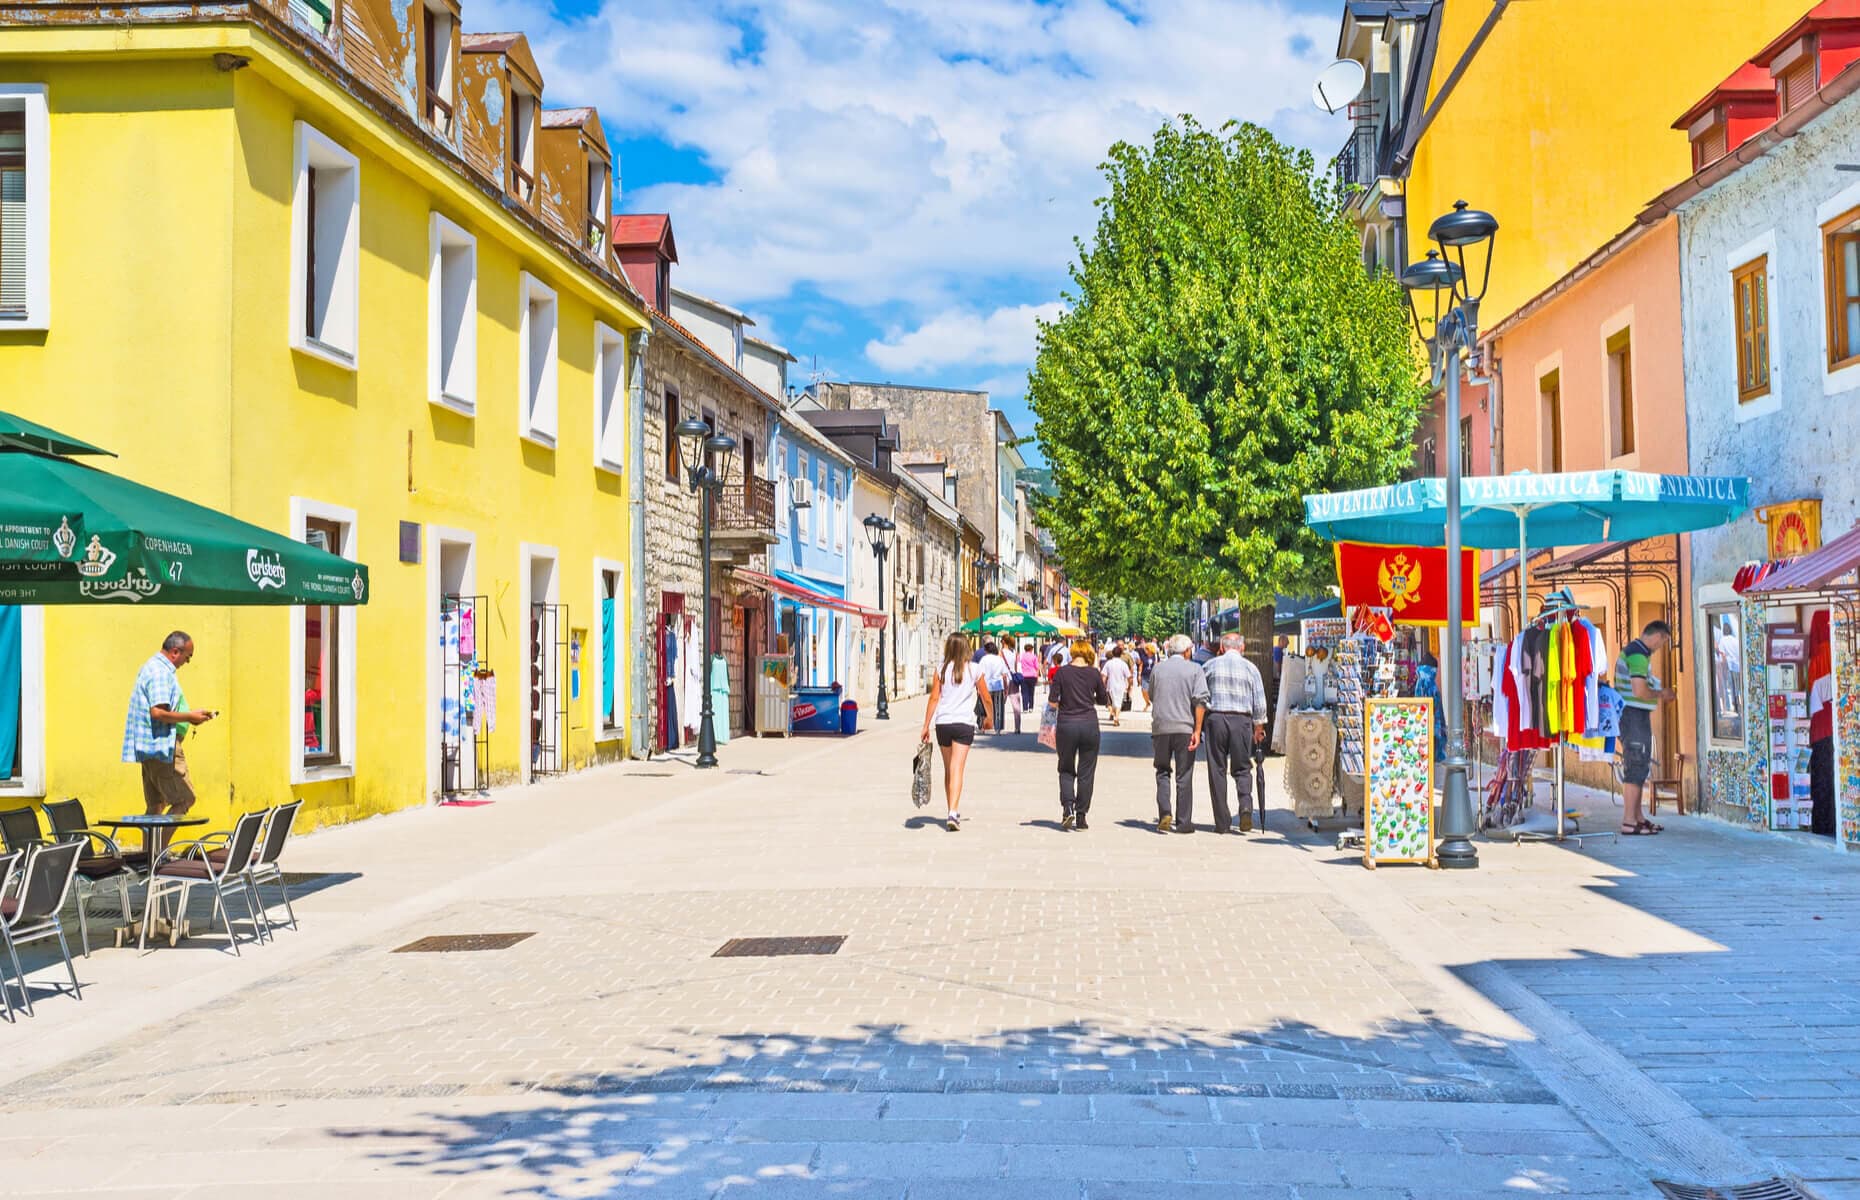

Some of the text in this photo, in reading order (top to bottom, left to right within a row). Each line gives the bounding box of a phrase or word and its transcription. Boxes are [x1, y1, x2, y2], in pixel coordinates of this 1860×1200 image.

[1436, 471, 1600, 501] SVENIRNICA
[1627, 474, 1736, 500] SUVENIRNICA
[1312, 483, 1415, 516] SUVENIRNICA
[5, 525, 42, 535] APPOINTMENT
[44, 527, 51, 536] TO
[5, 539, 30, 550] DANISH
[31, 539, 49, 550] COURT
[145, 537, 193, 556] COPENHAGEN
[246, 549, 286, 591] Carlsberg
